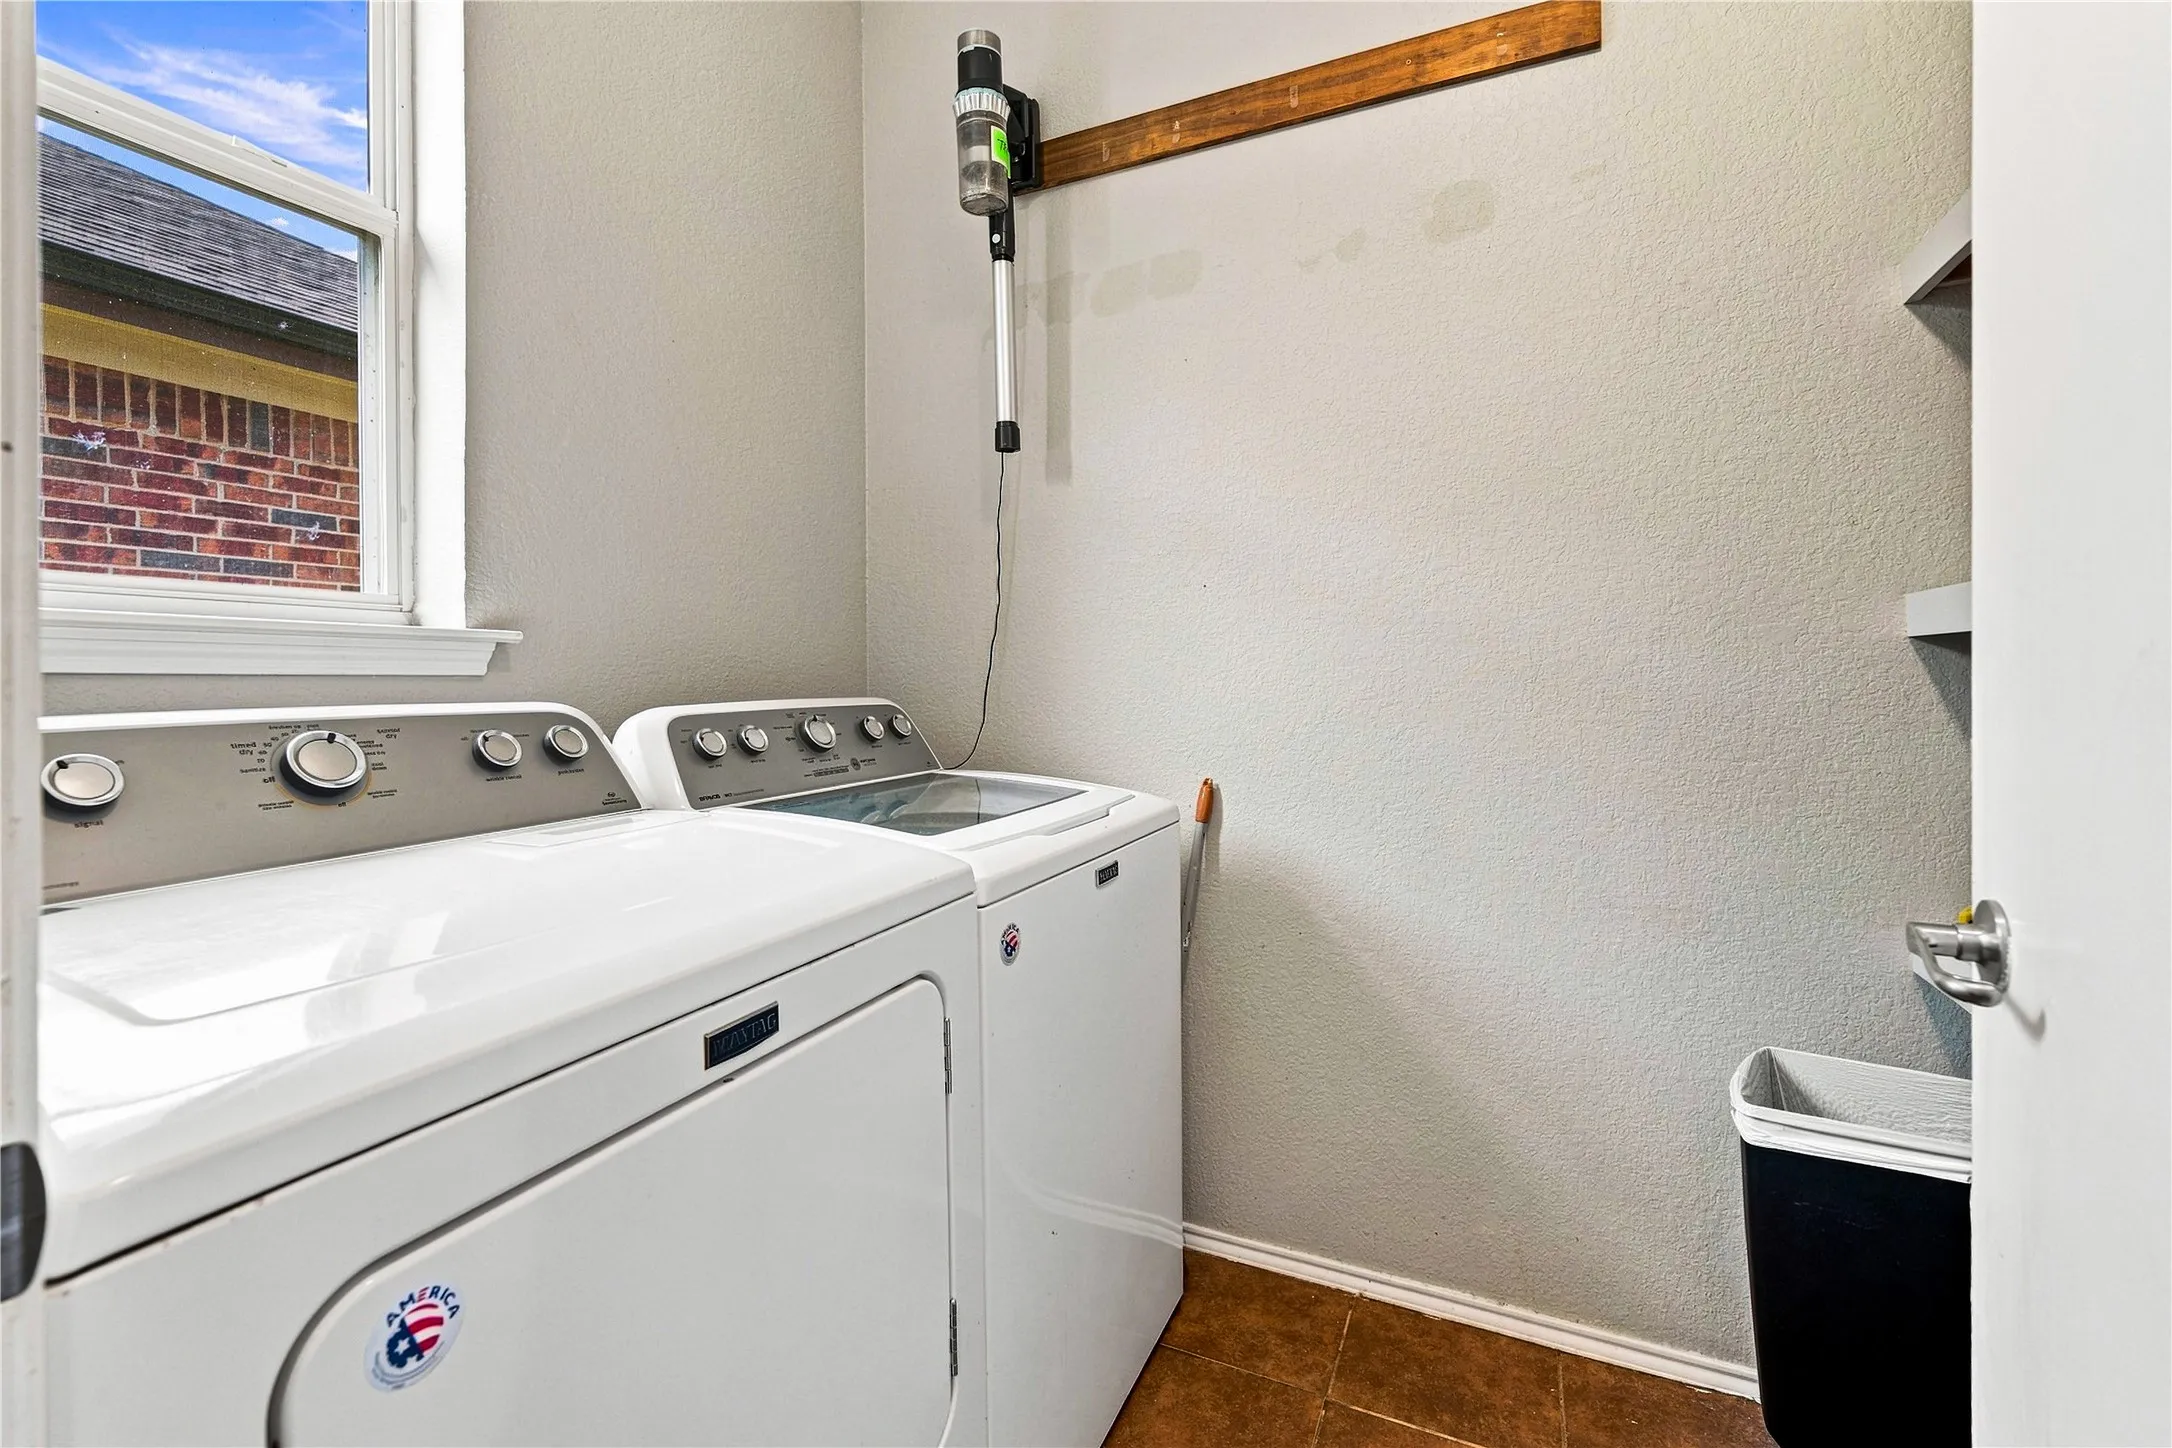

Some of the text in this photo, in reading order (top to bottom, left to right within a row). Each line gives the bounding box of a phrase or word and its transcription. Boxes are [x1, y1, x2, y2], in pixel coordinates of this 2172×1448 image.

[230, 741, 257, 749] timed
[263, 775, 276, 783] off
[712, 1012, 777, 1057] MAYTAG
[386, 1285, 460, 1328] AMERICA
